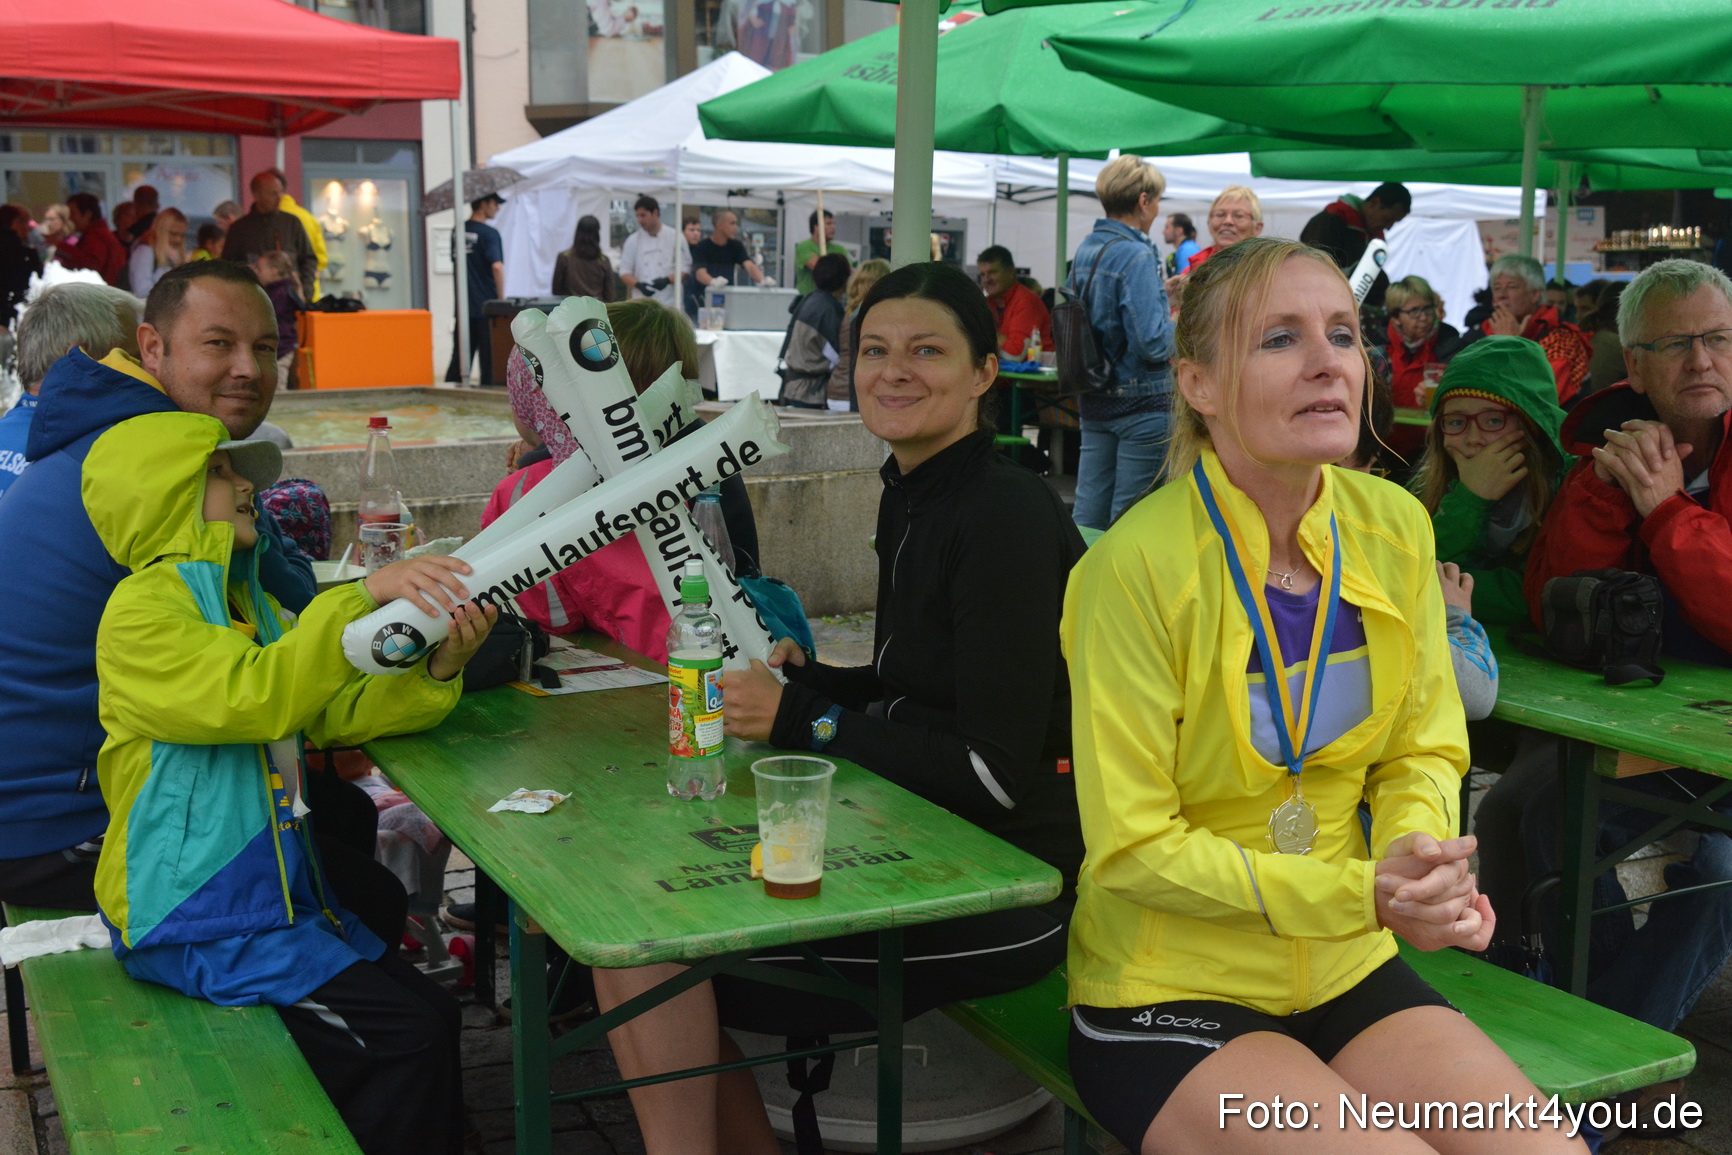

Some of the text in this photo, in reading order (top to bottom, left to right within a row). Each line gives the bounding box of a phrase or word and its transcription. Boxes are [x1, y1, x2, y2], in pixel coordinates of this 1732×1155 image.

[449, 440, 763, 622] mw-laufsport.de
[372, 624, 413, 651] BMW
[1156, 1014, 1221, 1030] odlo
